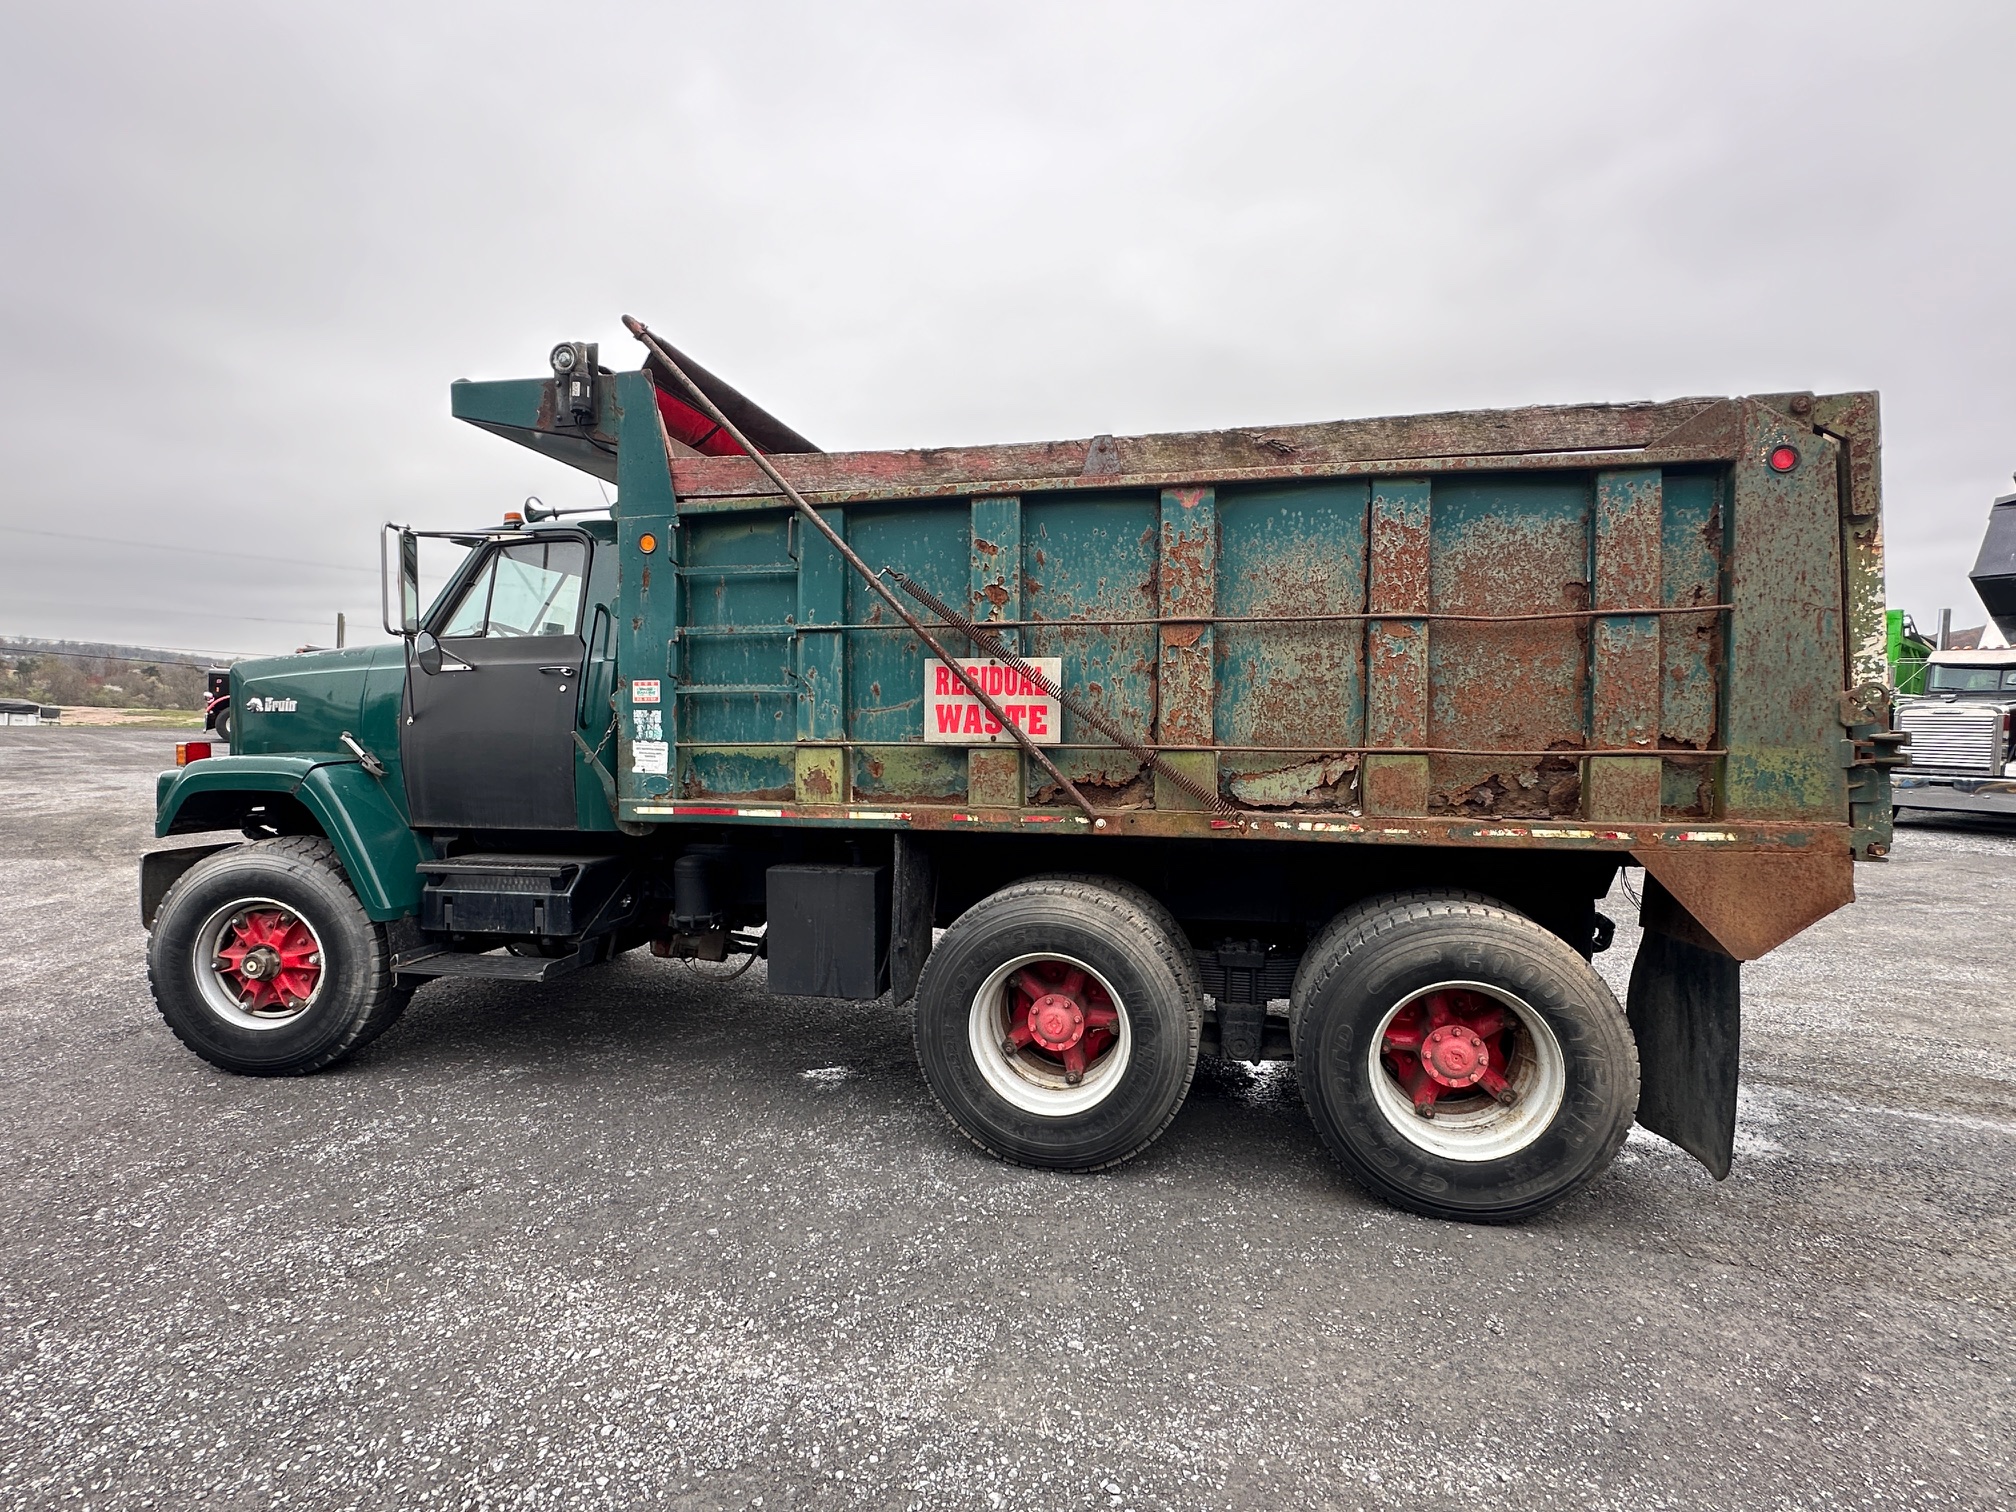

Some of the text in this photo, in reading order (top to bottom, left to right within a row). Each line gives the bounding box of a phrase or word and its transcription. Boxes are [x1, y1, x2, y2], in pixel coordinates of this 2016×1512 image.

[935, 666, 1047, 696] RESIDUAL
[264, 697, 297, 712] Bruin
[935, 704, 1047, 735] WASTE
[1456, 946, 1608, 1150] GOODYEAR
